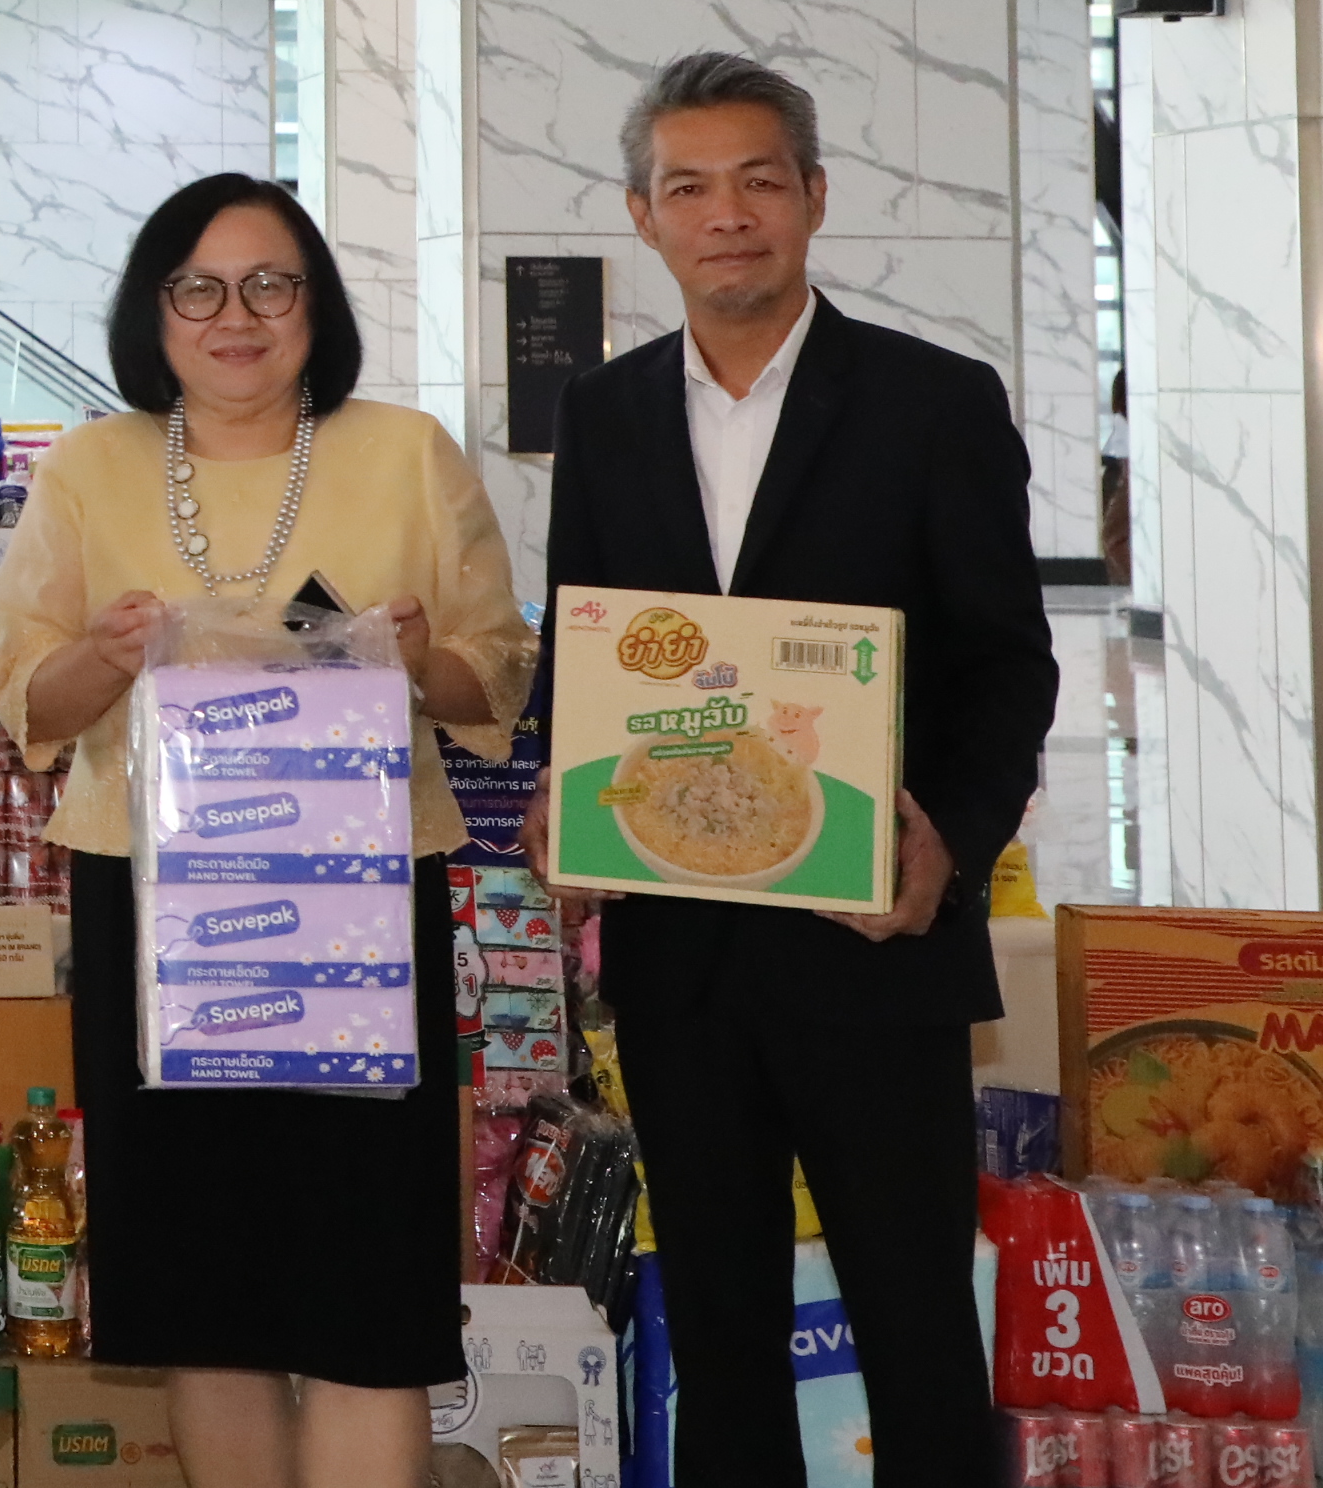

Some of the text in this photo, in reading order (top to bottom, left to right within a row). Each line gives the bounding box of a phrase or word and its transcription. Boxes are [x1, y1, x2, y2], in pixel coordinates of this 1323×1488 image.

[207, 692, 295, 722] Savepak
[221, 768, 257, 777] TOWEL
[449, 776, 519, 790] ลังใจให้ทหาร
[207, 797, 296, 826] Savepak
[465, 815, 525, 827] รวงการคลั
[188, 856, 270, 869] กระดาษเช็ดมือ
[188, 873, 257, 881] HAND TOWEL
[206, 905, 296, 935] Savepak
[187, 965, 270, 978] กระดาษเช็ดมือ
[210, 994, 300, 1024] Savepak
[191, 1053, 274, 1068] กระดาษเช็ดมือ
[191, 1069, 260, 1079] HAND TOWEL
[1033, 1242, 1091, 1287] เพิ่ม
[1189, 1300, 1225, 1316] aro
[1045, 1289, 1082, 1349] 3
[1032, 1351, 1094, 1380] ขวด
